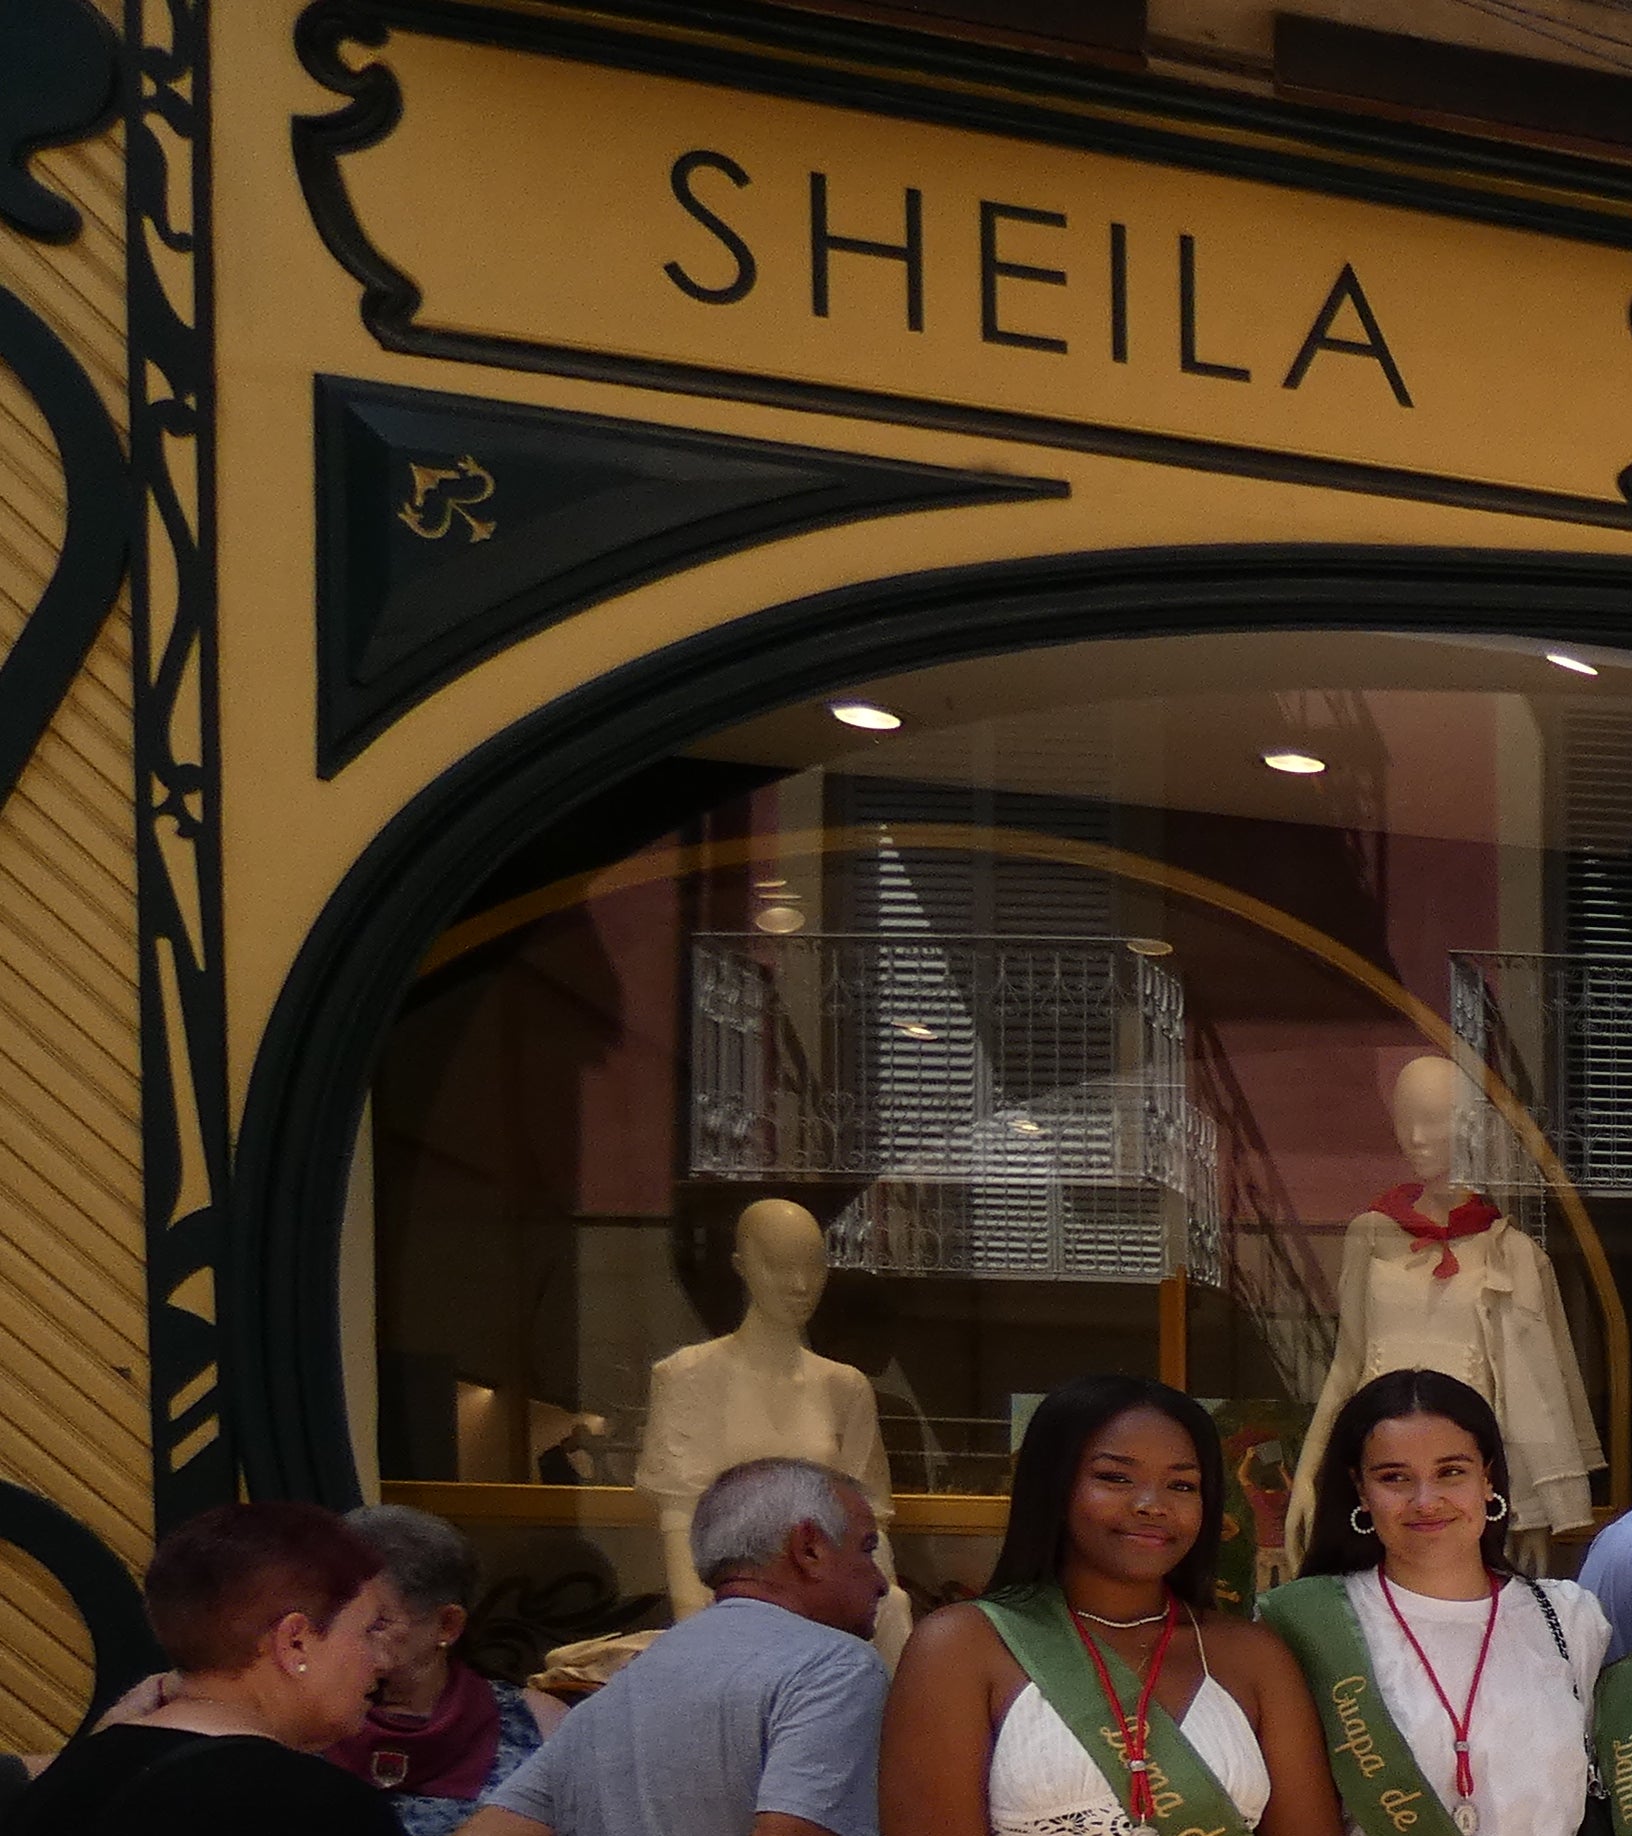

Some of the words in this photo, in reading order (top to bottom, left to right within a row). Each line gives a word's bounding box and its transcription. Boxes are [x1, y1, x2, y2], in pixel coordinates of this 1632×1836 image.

[663, 149, 1414, 408] SHEILA
[1333, 1675, 1385, 1778] Guapa
[1380, 1789, 1424, 1832] de
